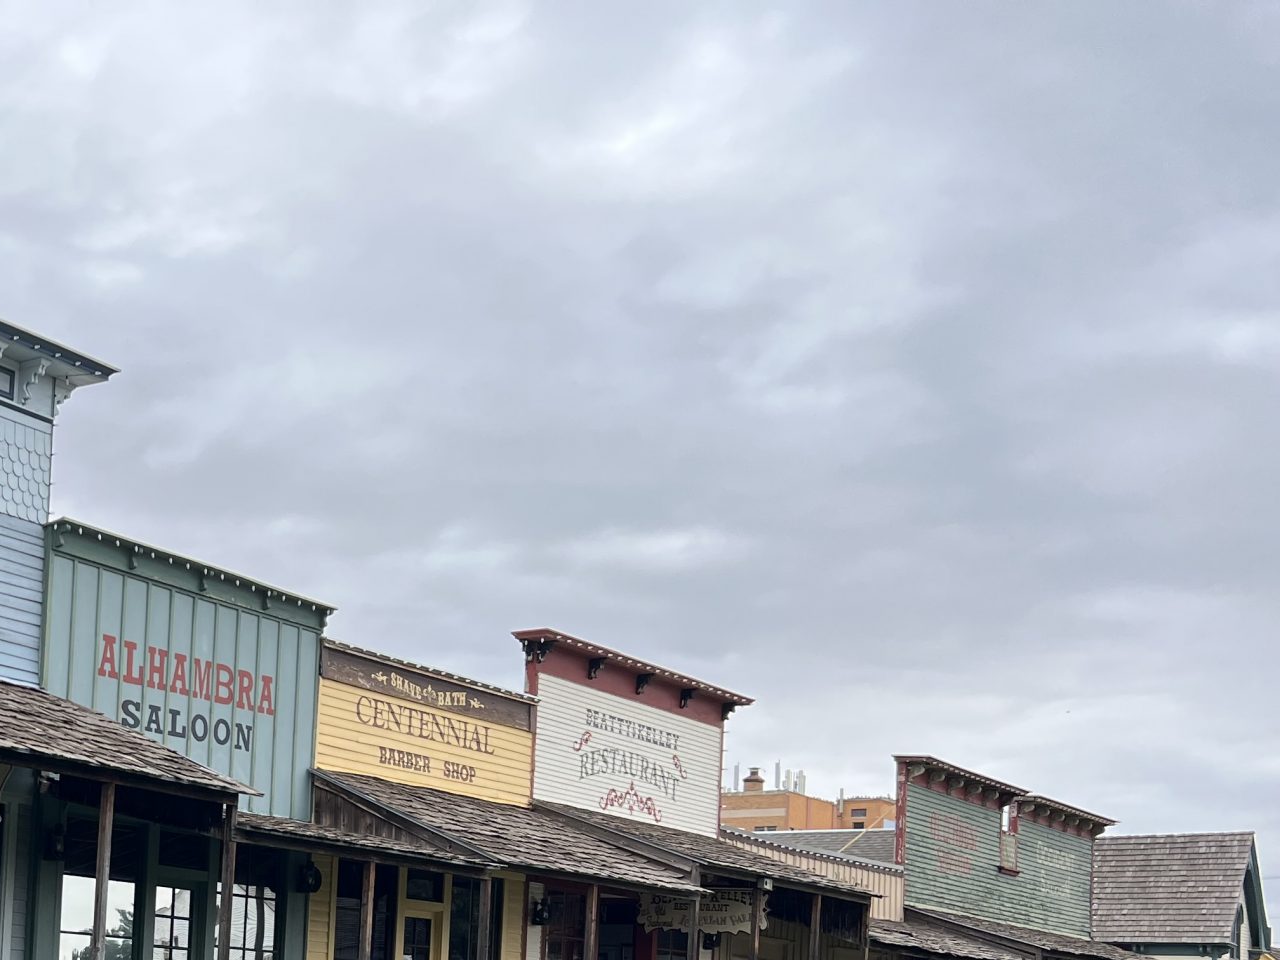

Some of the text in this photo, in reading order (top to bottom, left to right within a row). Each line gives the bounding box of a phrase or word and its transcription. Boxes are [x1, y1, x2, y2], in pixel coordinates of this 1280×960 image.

[97, 633, 276, 716] ALHAMBRA
[390, 672, 467, 707] SHAVE BATH
[121, 699, 253, 752] SALOON
[356, 695, 495, 756] CENTENNIAL
[378, 746, 476, 783] BARBER SHOP
[579, 748, 680, 801] RESTAURANT
[673, 903, 729, 912] RESURANT
